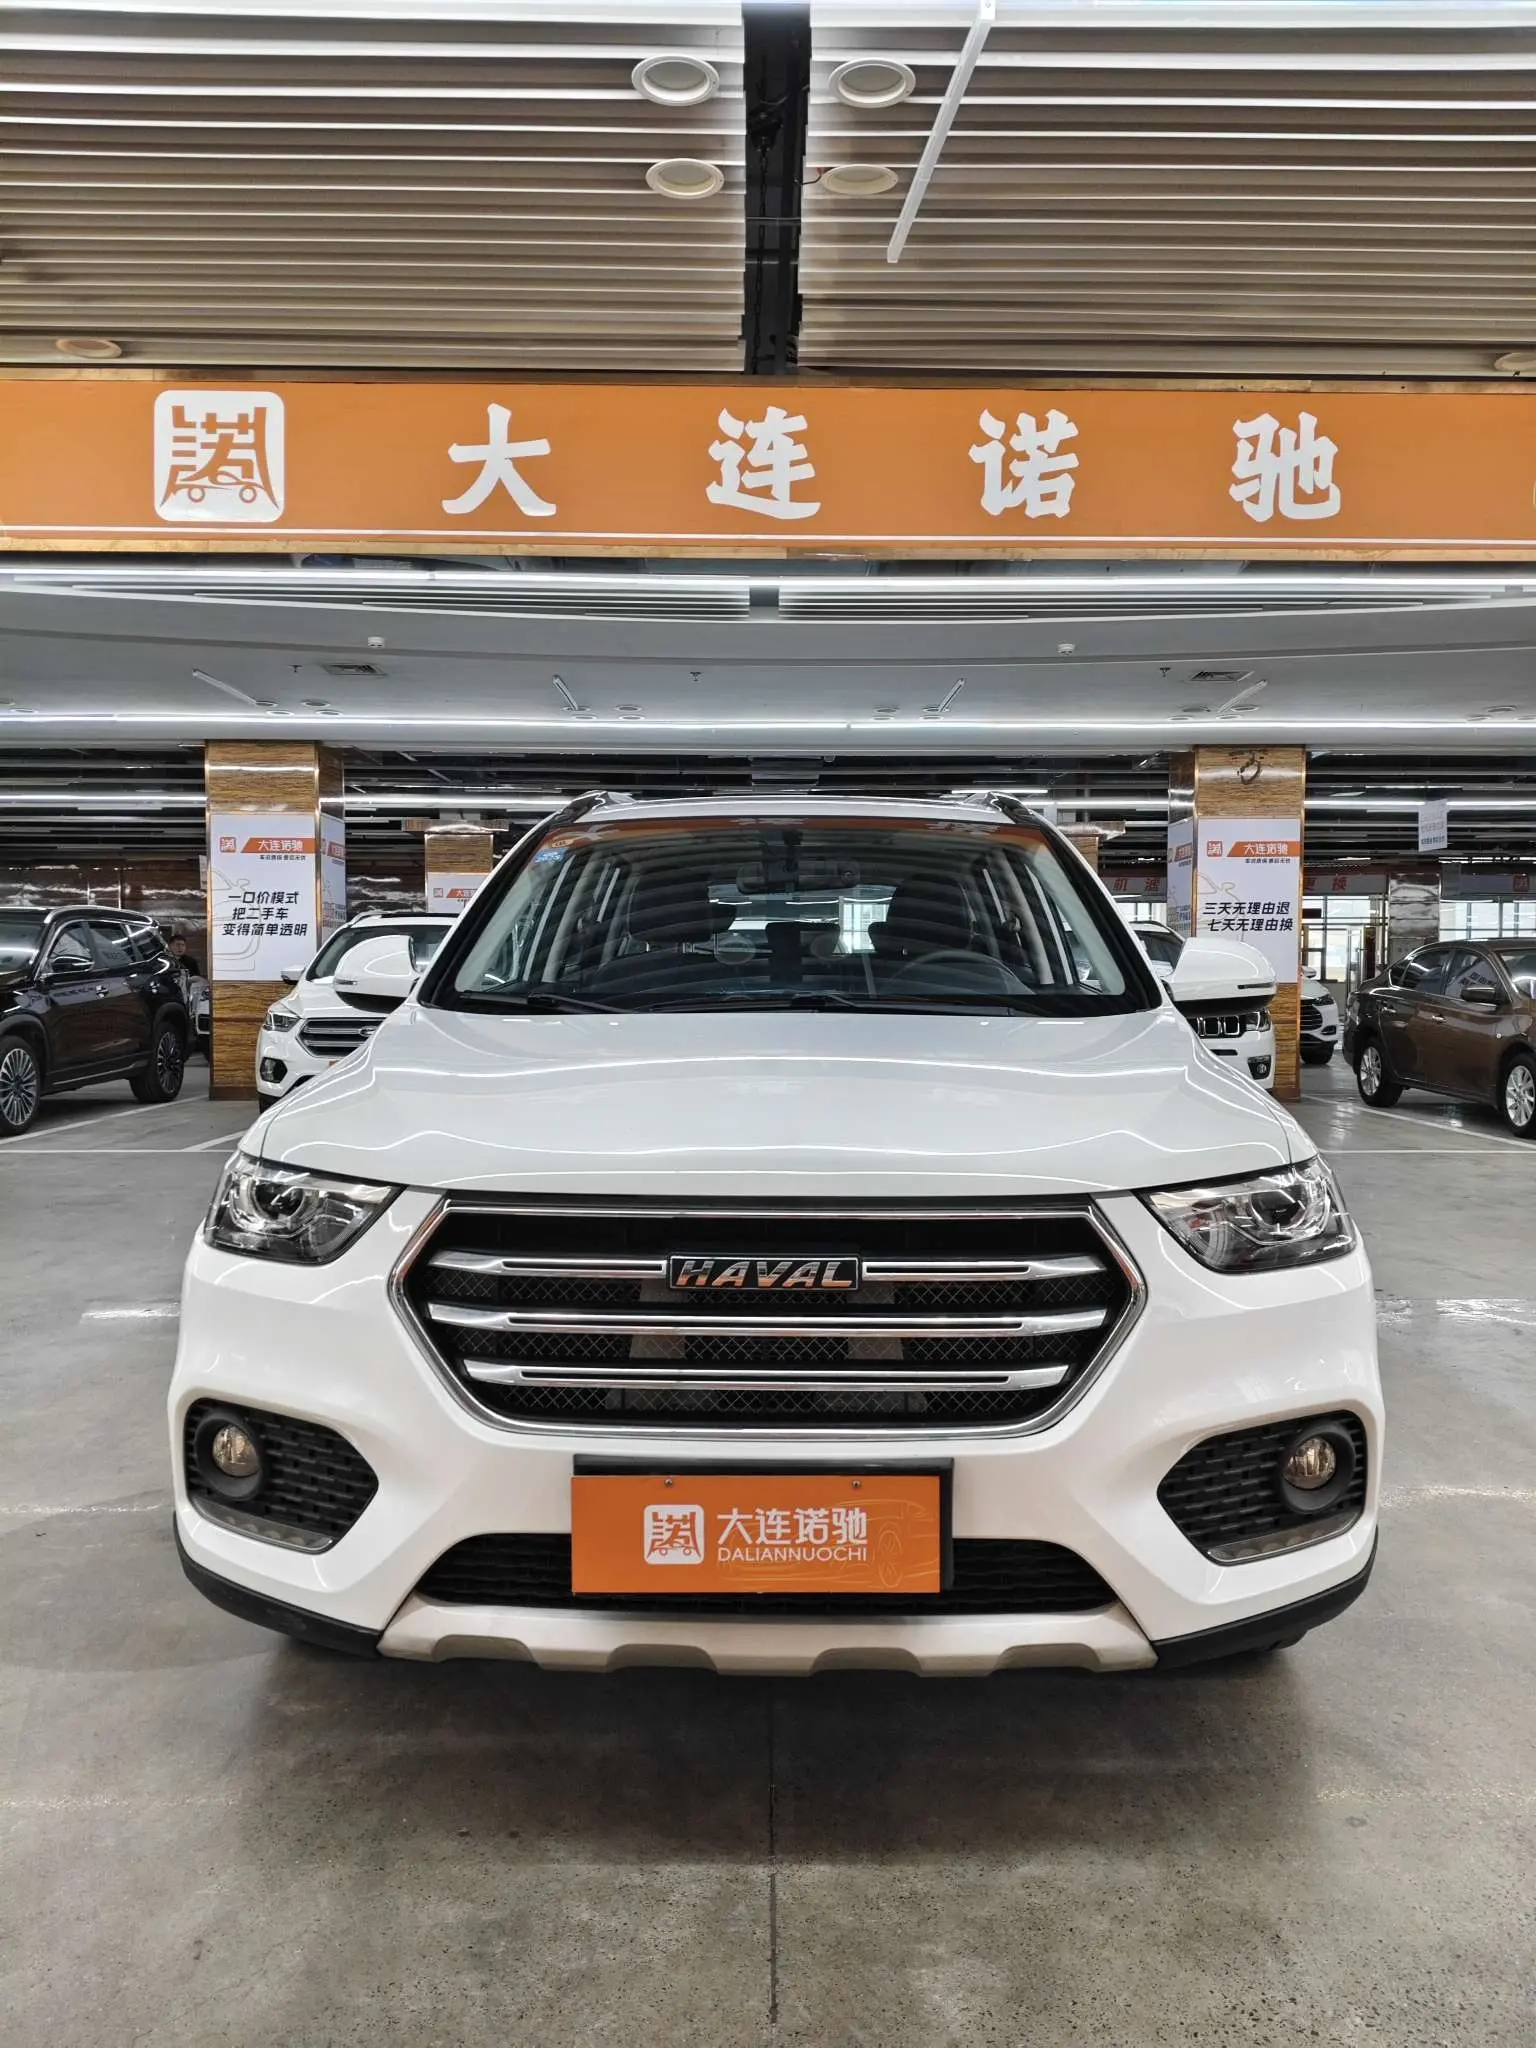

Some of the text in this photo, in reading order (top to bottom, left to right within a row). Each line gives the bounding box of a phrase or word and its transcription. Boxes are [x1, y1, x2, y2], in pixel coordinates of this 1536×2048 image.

[441, 402, 1341, 523] 大连诺驰
[257, 839, 304, 852] 大连诺驰
[1244, 843, 1289, 856] 大连诺驰
[228, 891, 299, 905] 一口价模式
[232, 907, 289, 921] 把二手车
[1202, 901, 1291, 916] 三天无理由退
[222, 923, 308, 937] 变得简单透明
[1207, 918, 1294, 933] 七天无理由换
[675, 1260, 853, 1288] HAVAL
[716, 1507, 869, 1546] 大连诺驰
[717, 1547, 868, 1562] DALIANNUOCHI
